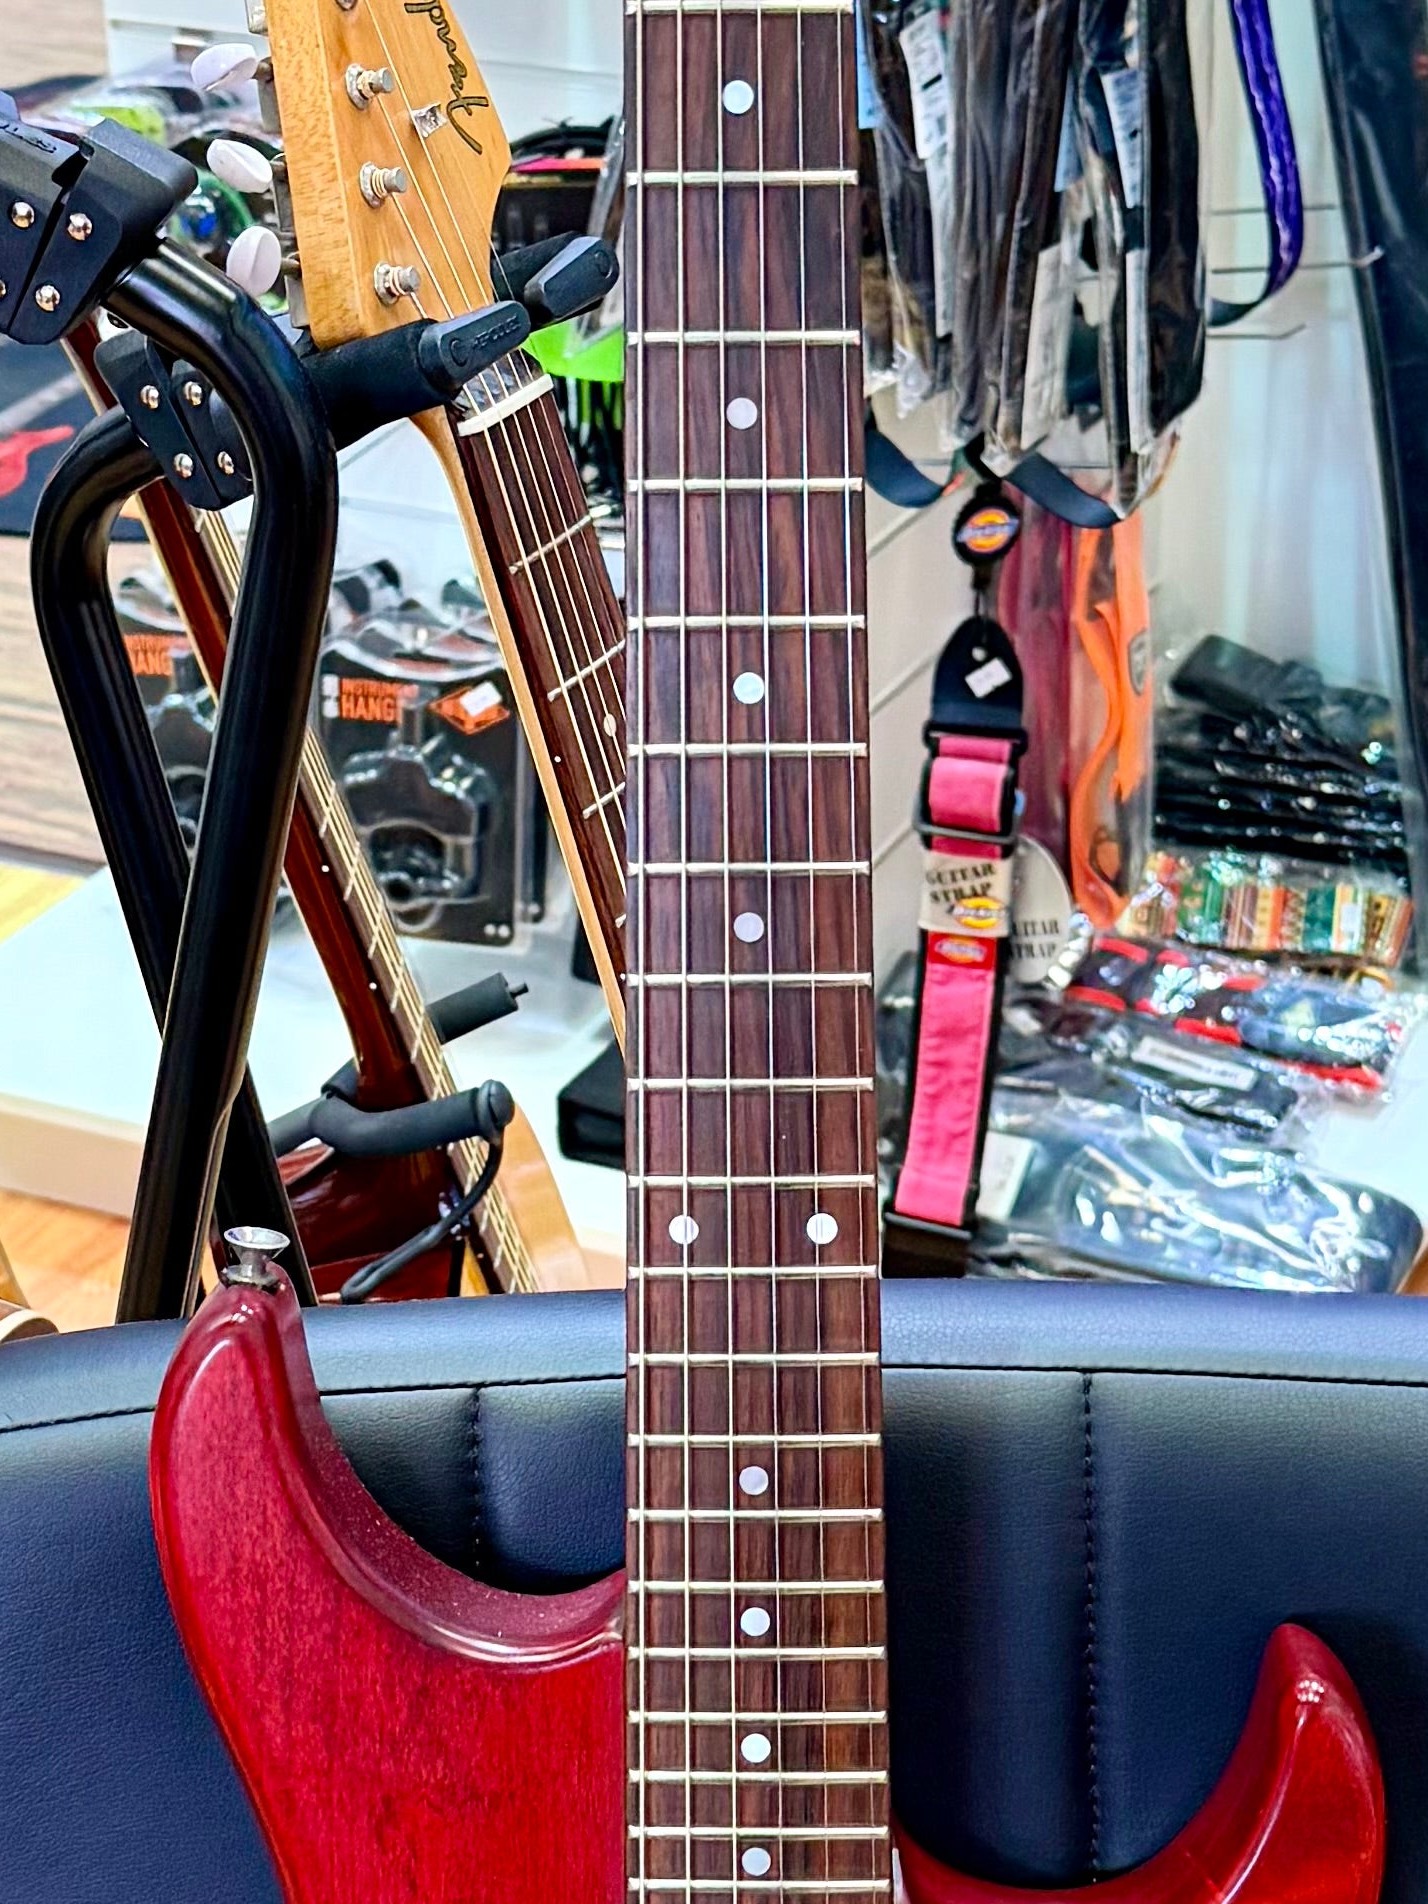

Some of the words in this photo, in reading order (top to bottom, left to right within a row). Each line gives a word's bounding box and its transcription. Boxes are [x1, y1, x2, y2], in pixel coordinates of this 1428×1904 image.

[341, 696, 402, 725] HANG
[926, 862, 996, 886] GUITAR
[929, 880, 992, 903] STRAP
[1011, 918, 1060, 937] UITAR
